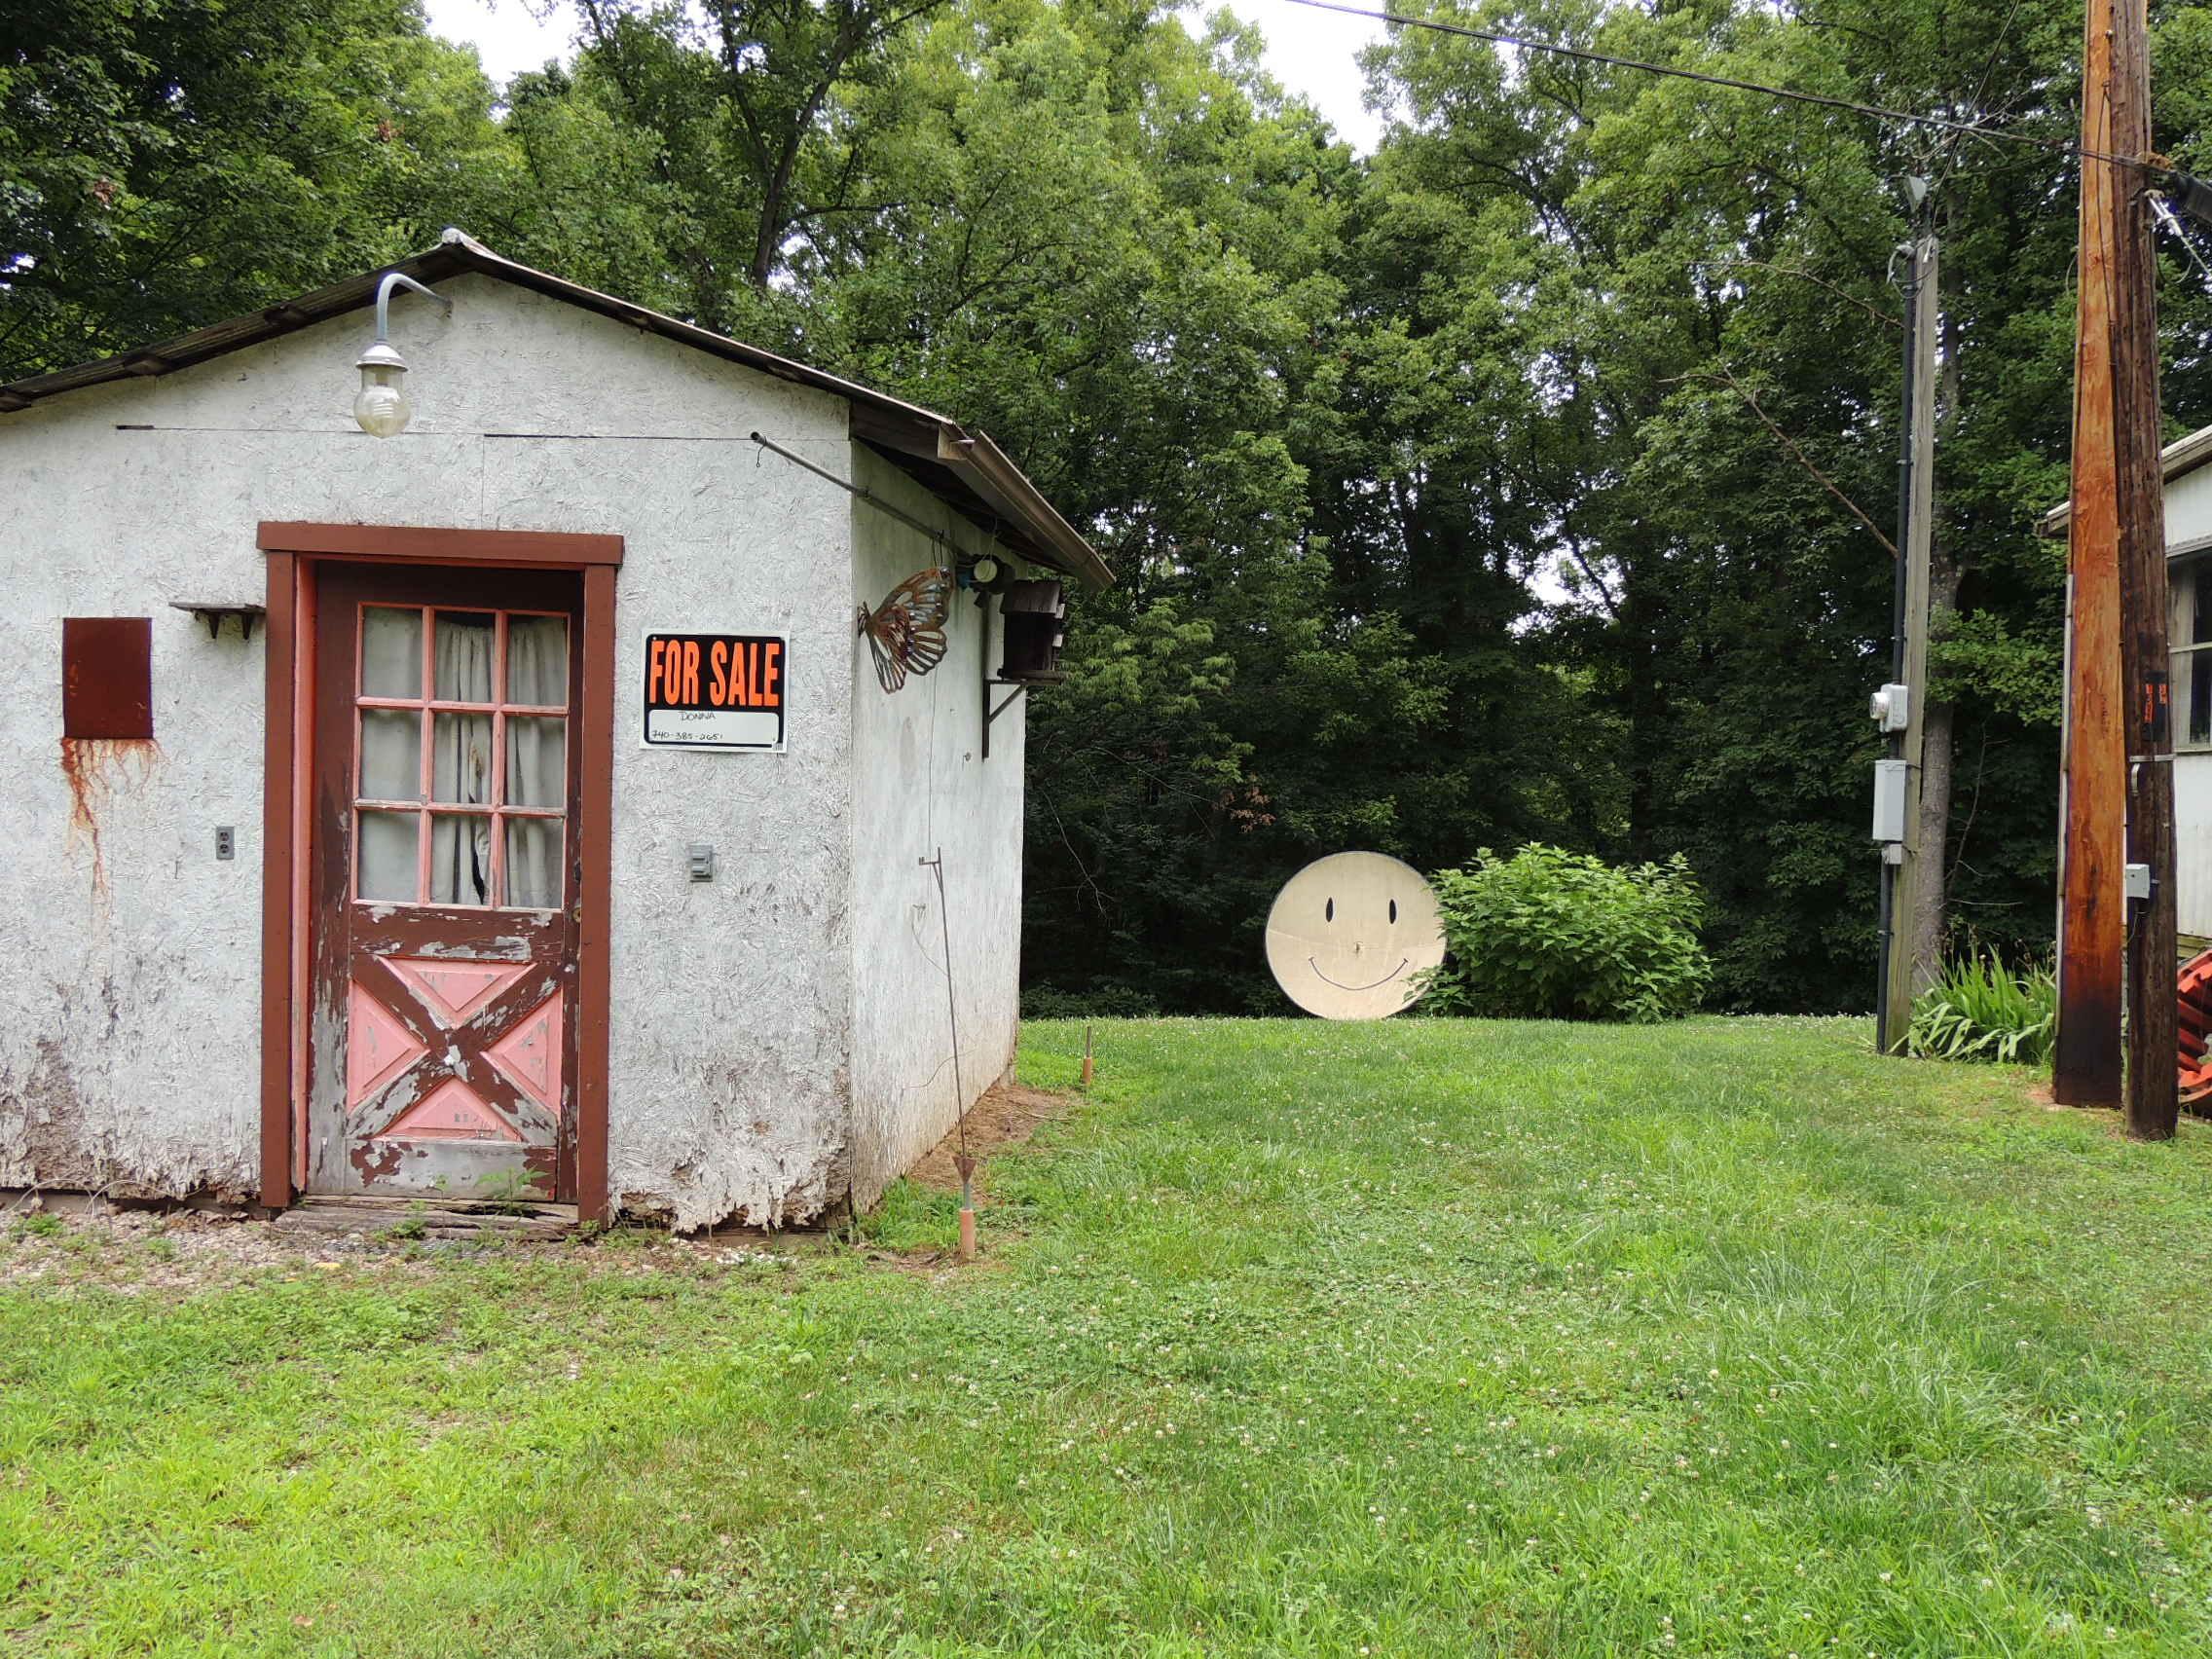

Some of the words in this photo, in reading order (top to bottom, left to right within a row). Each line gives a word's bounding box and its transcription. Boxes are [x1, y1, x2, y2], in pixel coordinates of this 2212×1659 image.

[648, 640, 700, 705] FOR
[709, 641, 780, 706] SALE
[679, 711, 717, 721] DONNA
